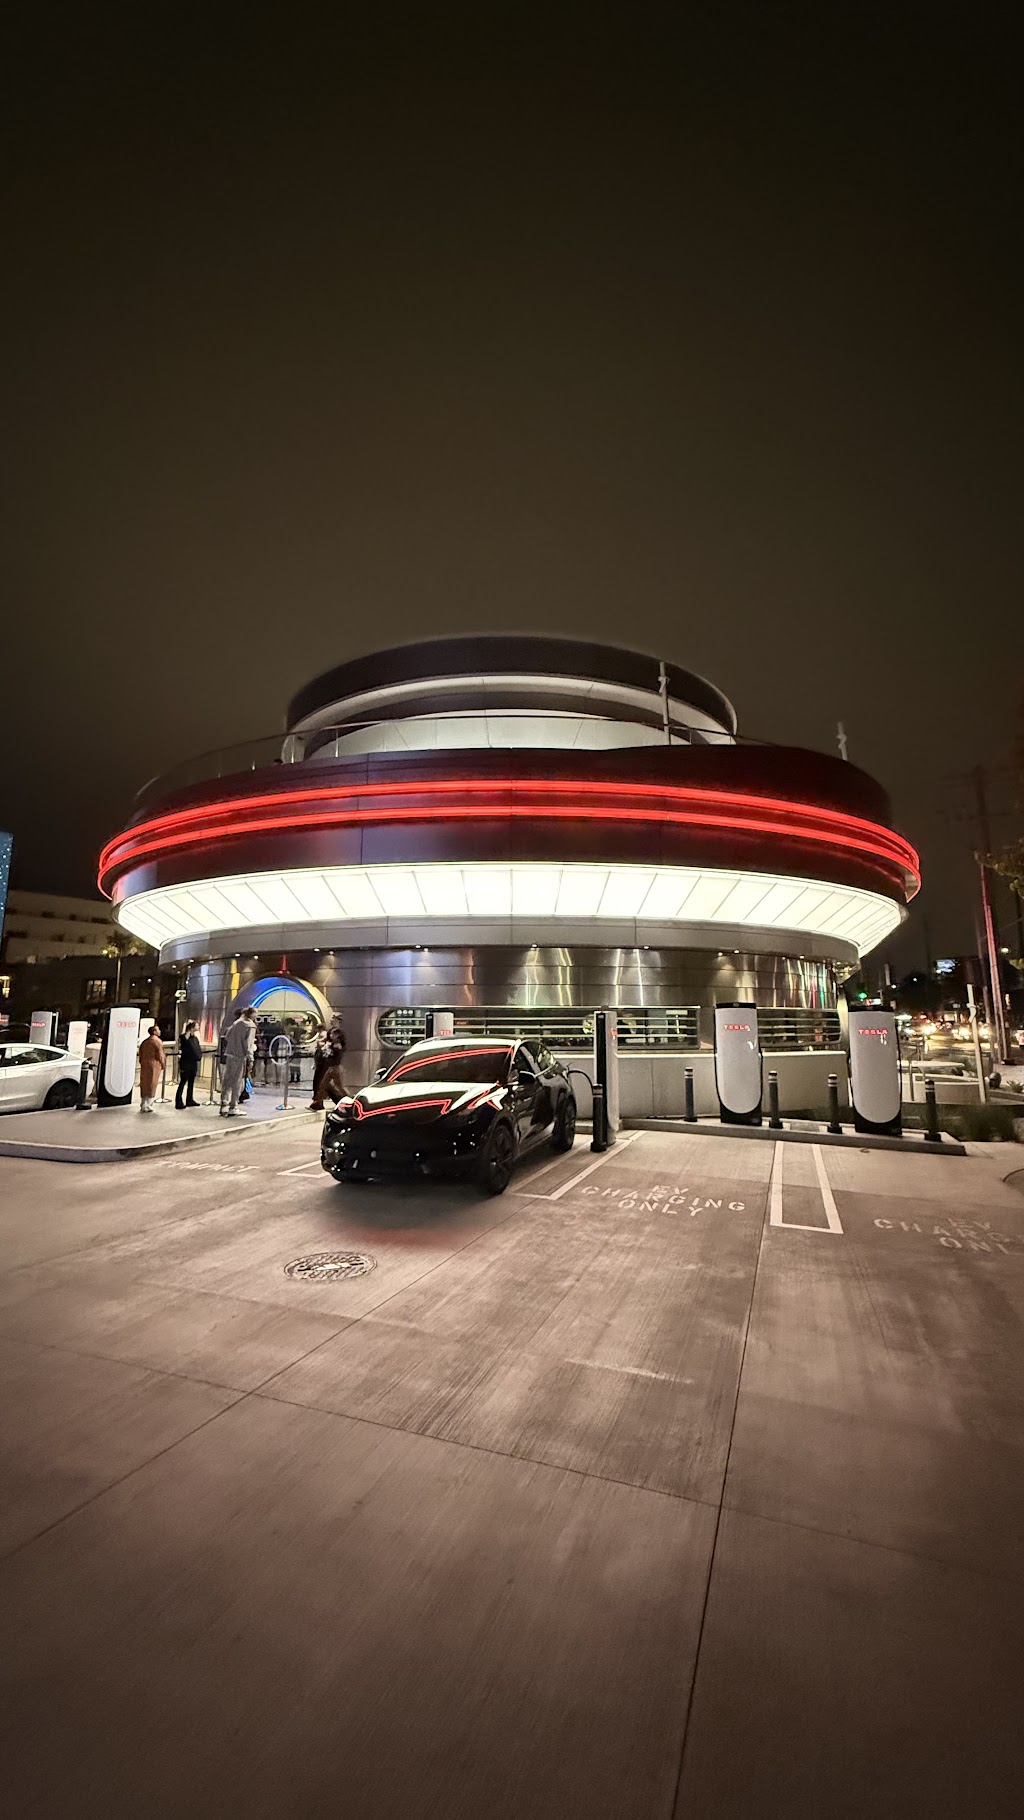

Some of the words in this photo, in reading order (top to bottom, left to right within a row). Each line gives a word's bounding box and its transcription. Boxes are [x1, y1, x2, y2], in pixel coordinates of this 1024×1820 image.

[580, 1186, 746, 1211] CHARGING
[652, 1185, 690, 1195] EV
[617, 1199, 704, 1217] ONLY
